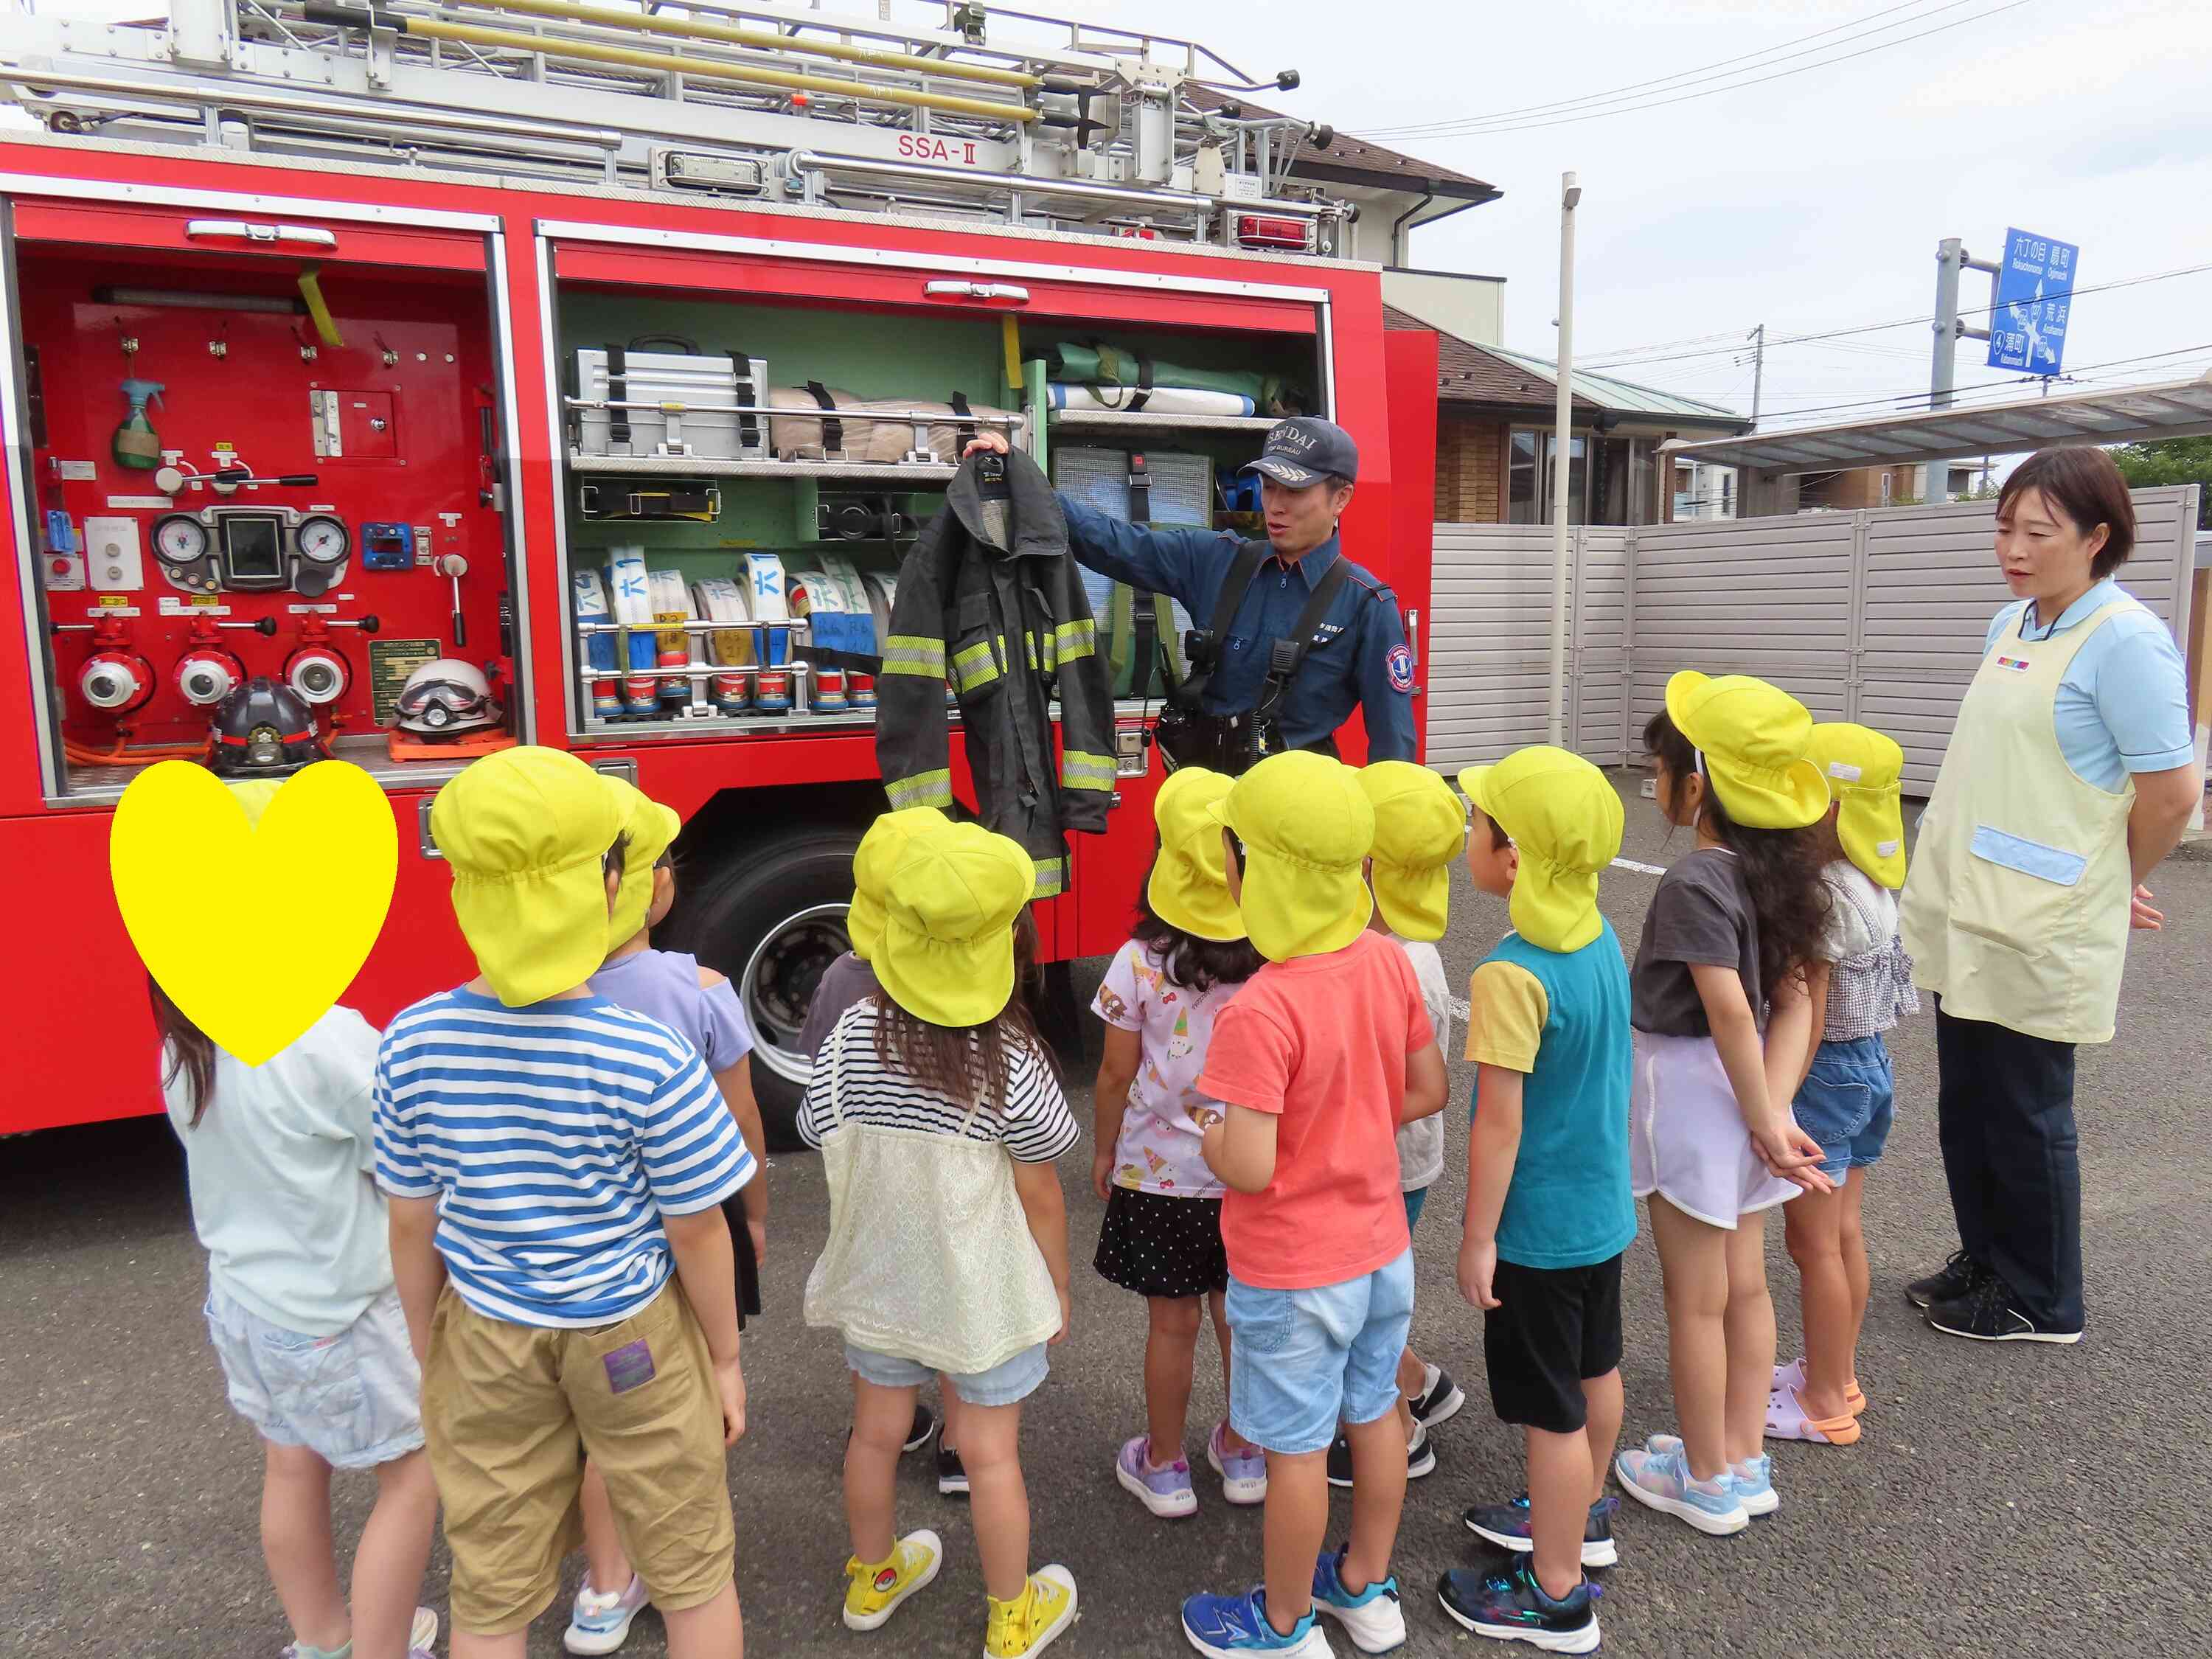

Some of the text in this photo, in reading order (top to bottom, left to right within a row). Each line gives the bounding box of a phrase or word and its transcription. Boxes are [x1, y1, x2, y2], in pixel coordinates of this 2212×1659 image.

[2014, 236, 2047, 262] 六丁の目
[1996, 334, 2003, 348] 4
